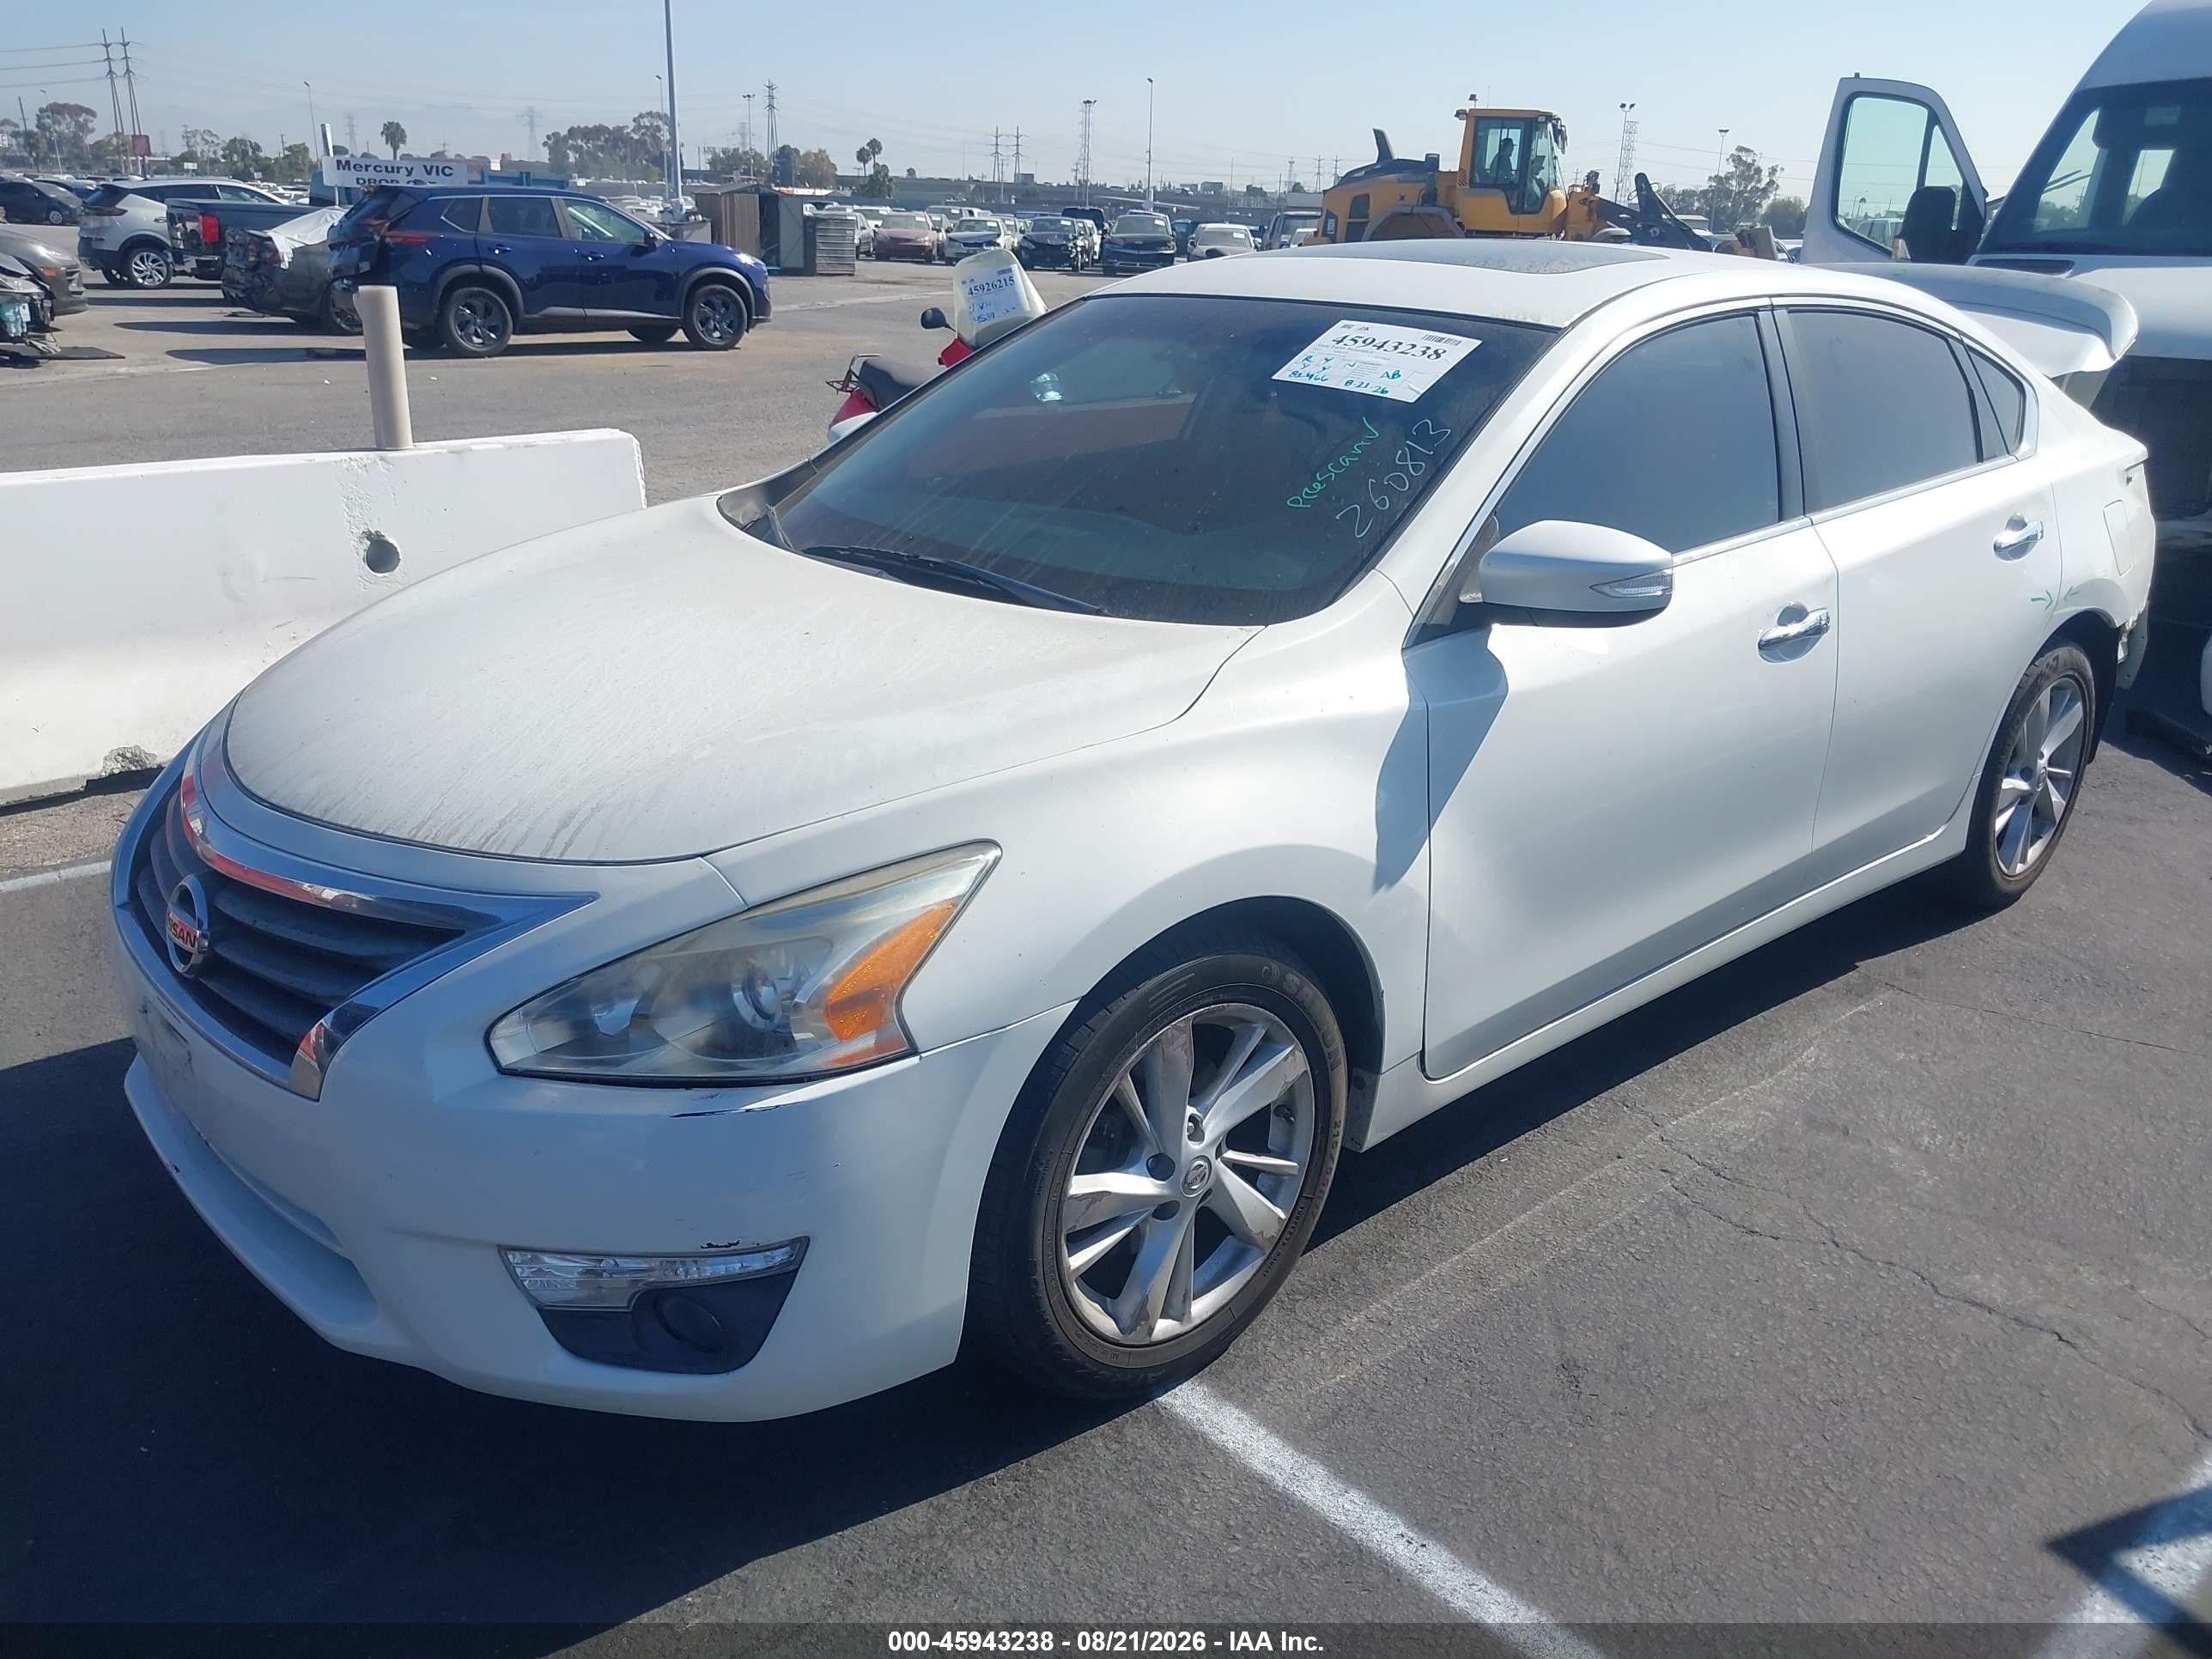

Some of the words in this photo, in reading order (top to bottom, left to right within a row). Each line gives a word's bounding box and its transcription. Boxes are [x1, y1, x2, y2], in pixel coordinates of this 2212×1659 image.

[336, 160, 415, 177] Mercury
[422, 164, 454, 177] VIC
[969, 276, 1015, 296] 45926215
[1332, 333, 1448, 362] 45943238
[1334, 418, 1451, 538] 260813
